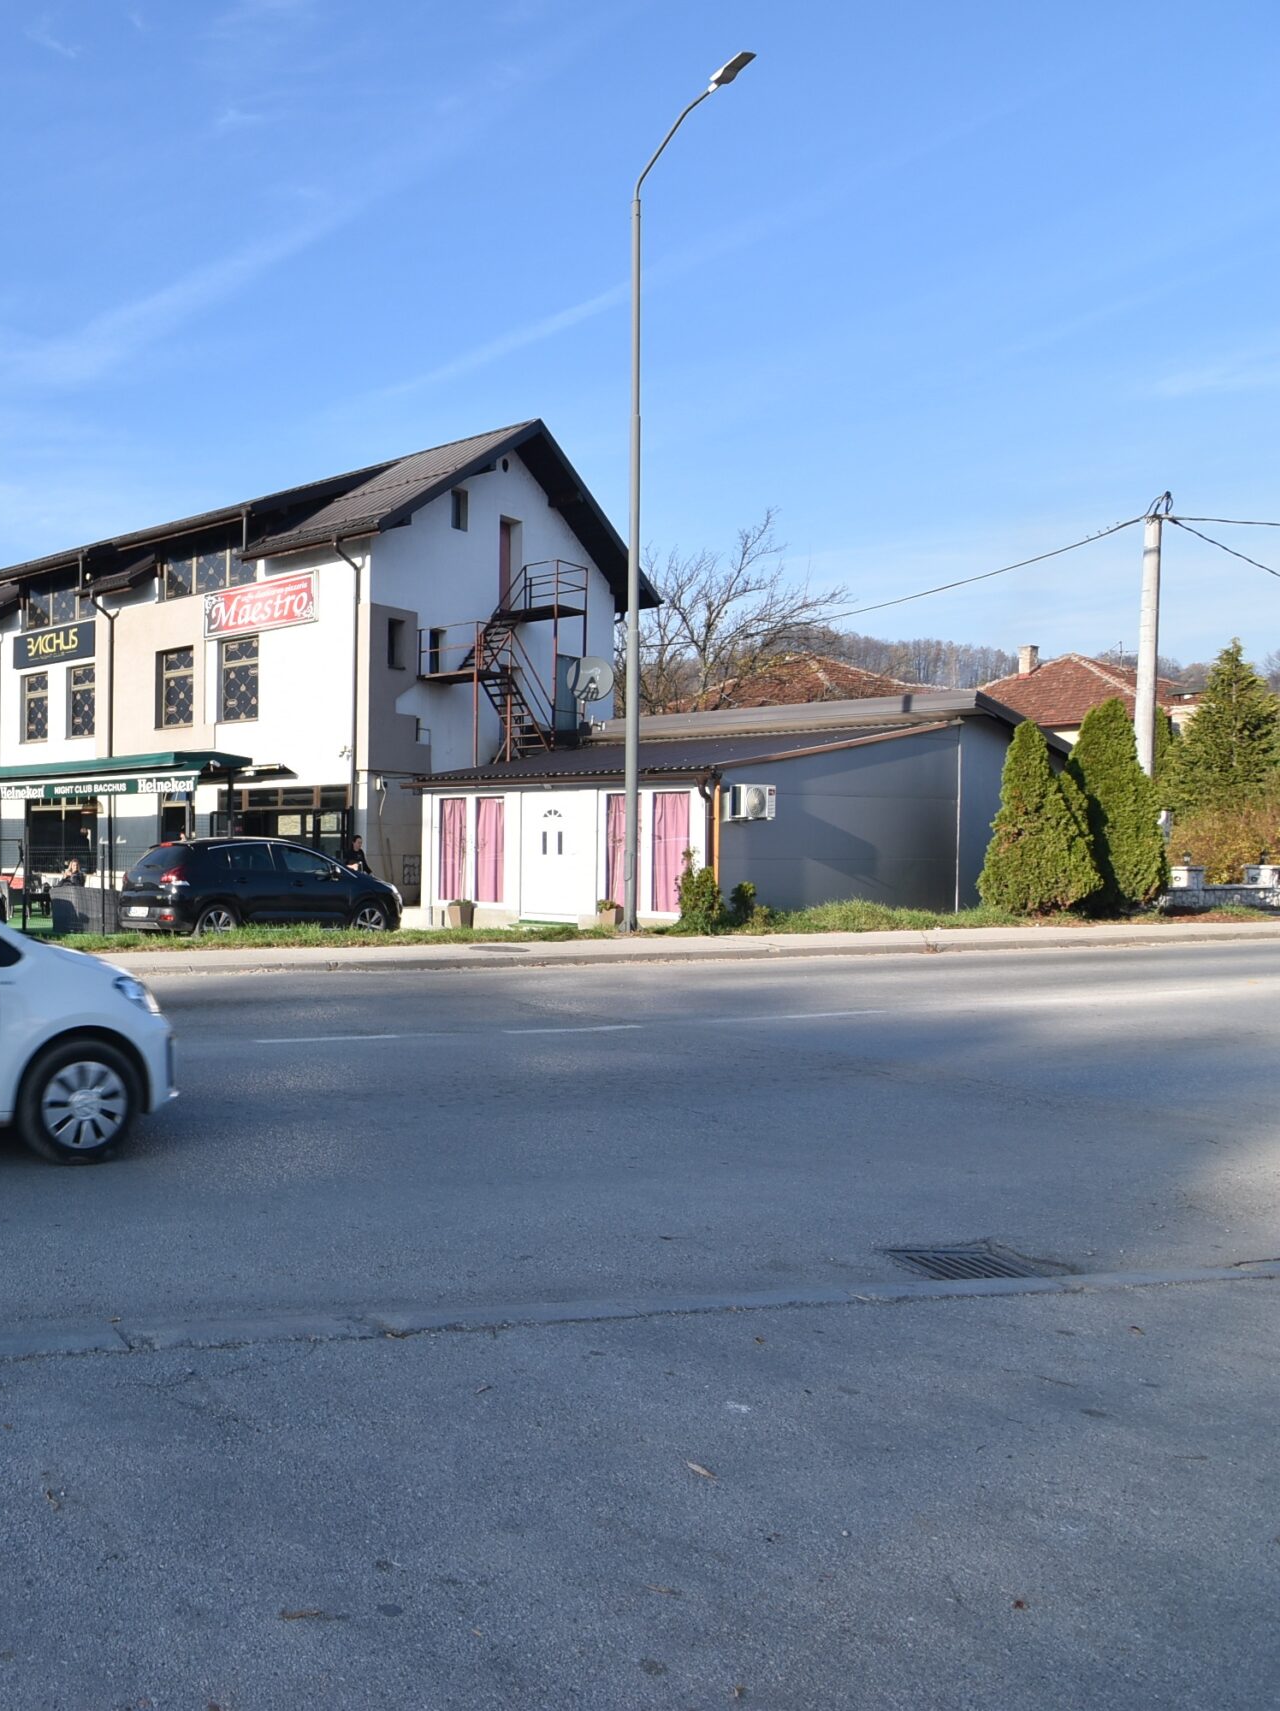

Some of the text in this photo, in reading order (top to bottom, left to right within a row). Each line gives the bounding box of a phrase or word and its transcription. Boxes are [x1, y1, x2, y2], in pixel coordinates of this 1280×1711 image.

[210, 592, 309, 630] Maestro
[26, 628, 78, 656] BACCHUS
[0, 785, 45, 800] Heineken
[54, 783, 127, 794] NIGHT CLUB BACCHUS
[137, 777, 195, 793] Heineken
